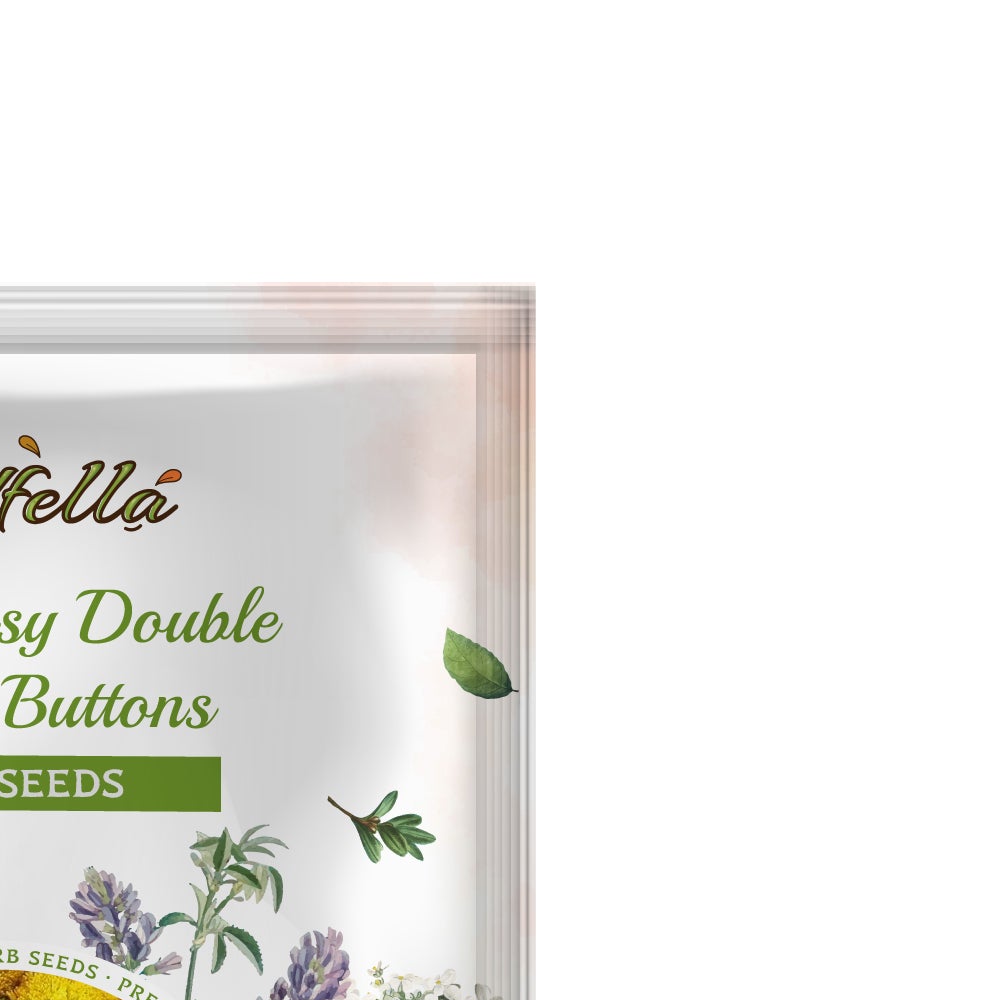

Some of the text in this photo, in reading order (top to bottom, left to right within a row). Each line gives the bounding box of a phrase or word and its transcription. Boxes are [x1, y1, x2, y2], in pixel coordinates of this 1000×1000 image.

[76, 586, 283, 645] Double
[1, 673, 219, 729] Buttons
[27, 950, 99, 980] SEEDS
